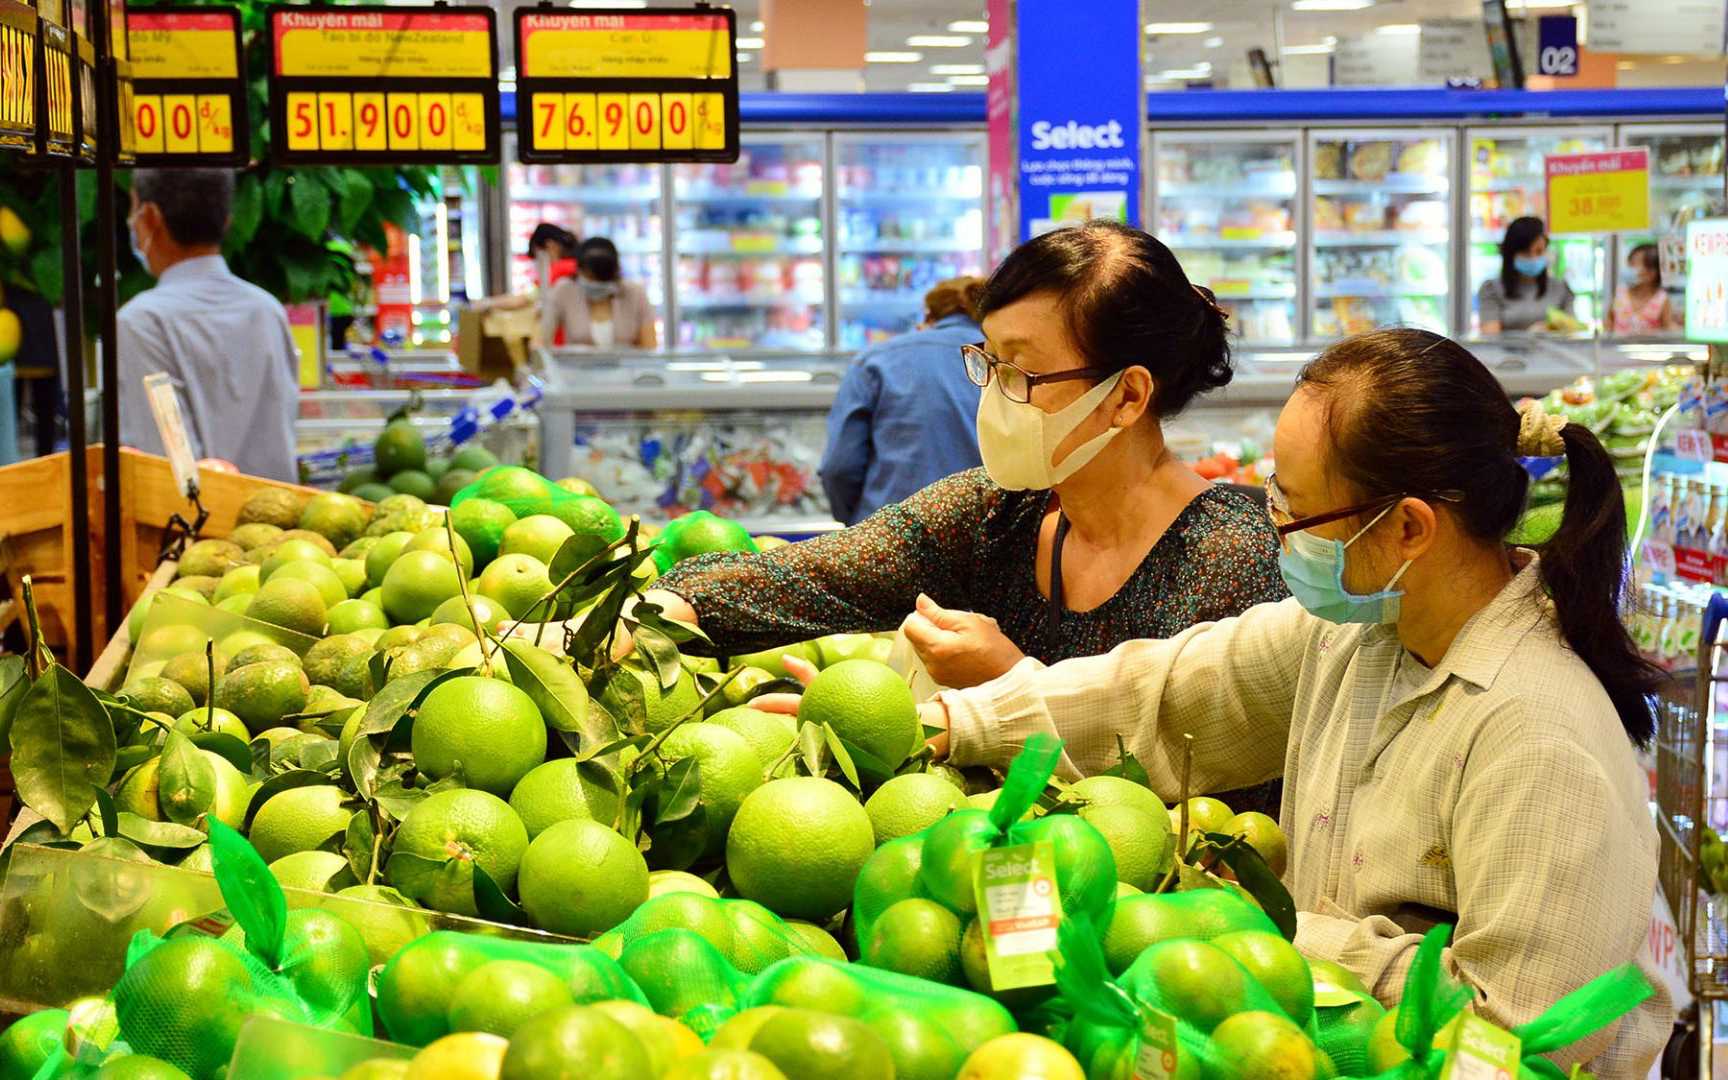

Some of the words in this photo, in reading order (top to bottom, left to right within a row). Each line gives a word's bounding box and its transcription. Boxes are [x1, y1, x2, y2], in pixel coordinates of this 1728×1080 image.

[1541, 47, 1576, 75] 02
[295, 102, 447, 138] 51.900
[539, 101, 687, 138] 76.900
[1031, 119, 1125, 151] Select
[985, 859, 1041, 880] Select
